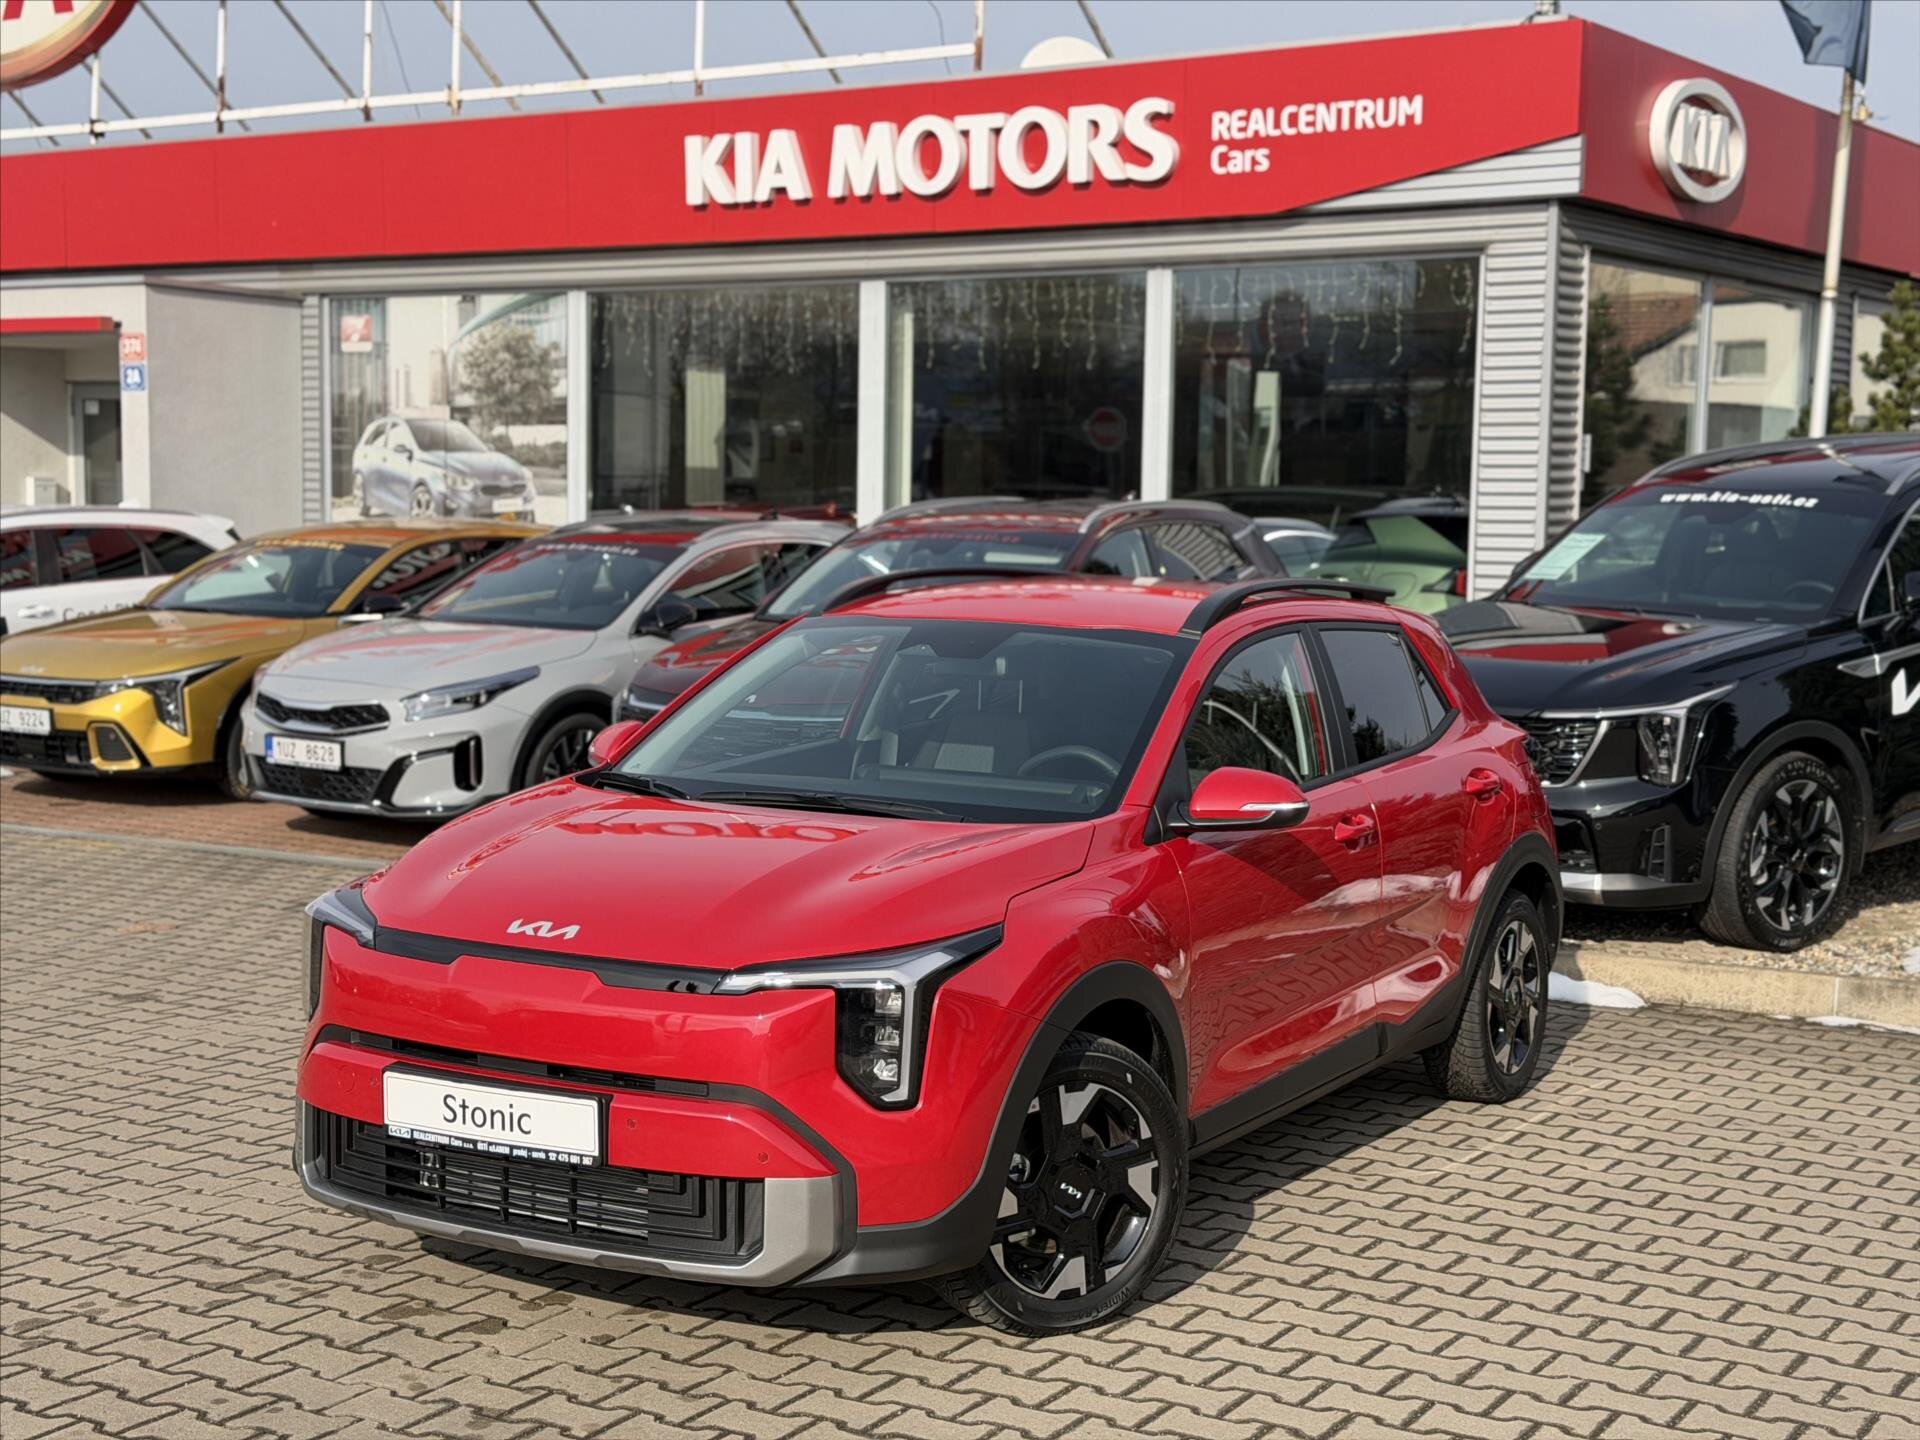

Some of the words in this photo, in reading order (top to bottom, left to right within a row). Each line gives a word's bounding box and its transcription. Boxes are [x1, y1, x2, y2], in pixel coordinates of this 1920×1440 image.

[1210, 93, 1424, 142] REALCENTRUM
[1669, 101, 1730, 179] KIA
[684, 128, 813, 206] KIA
[827, 96, 1181, 200] MOTORS
[1210, 144, 1271, 176] Cars
[443, 1093, 532, 1135] Stonic
